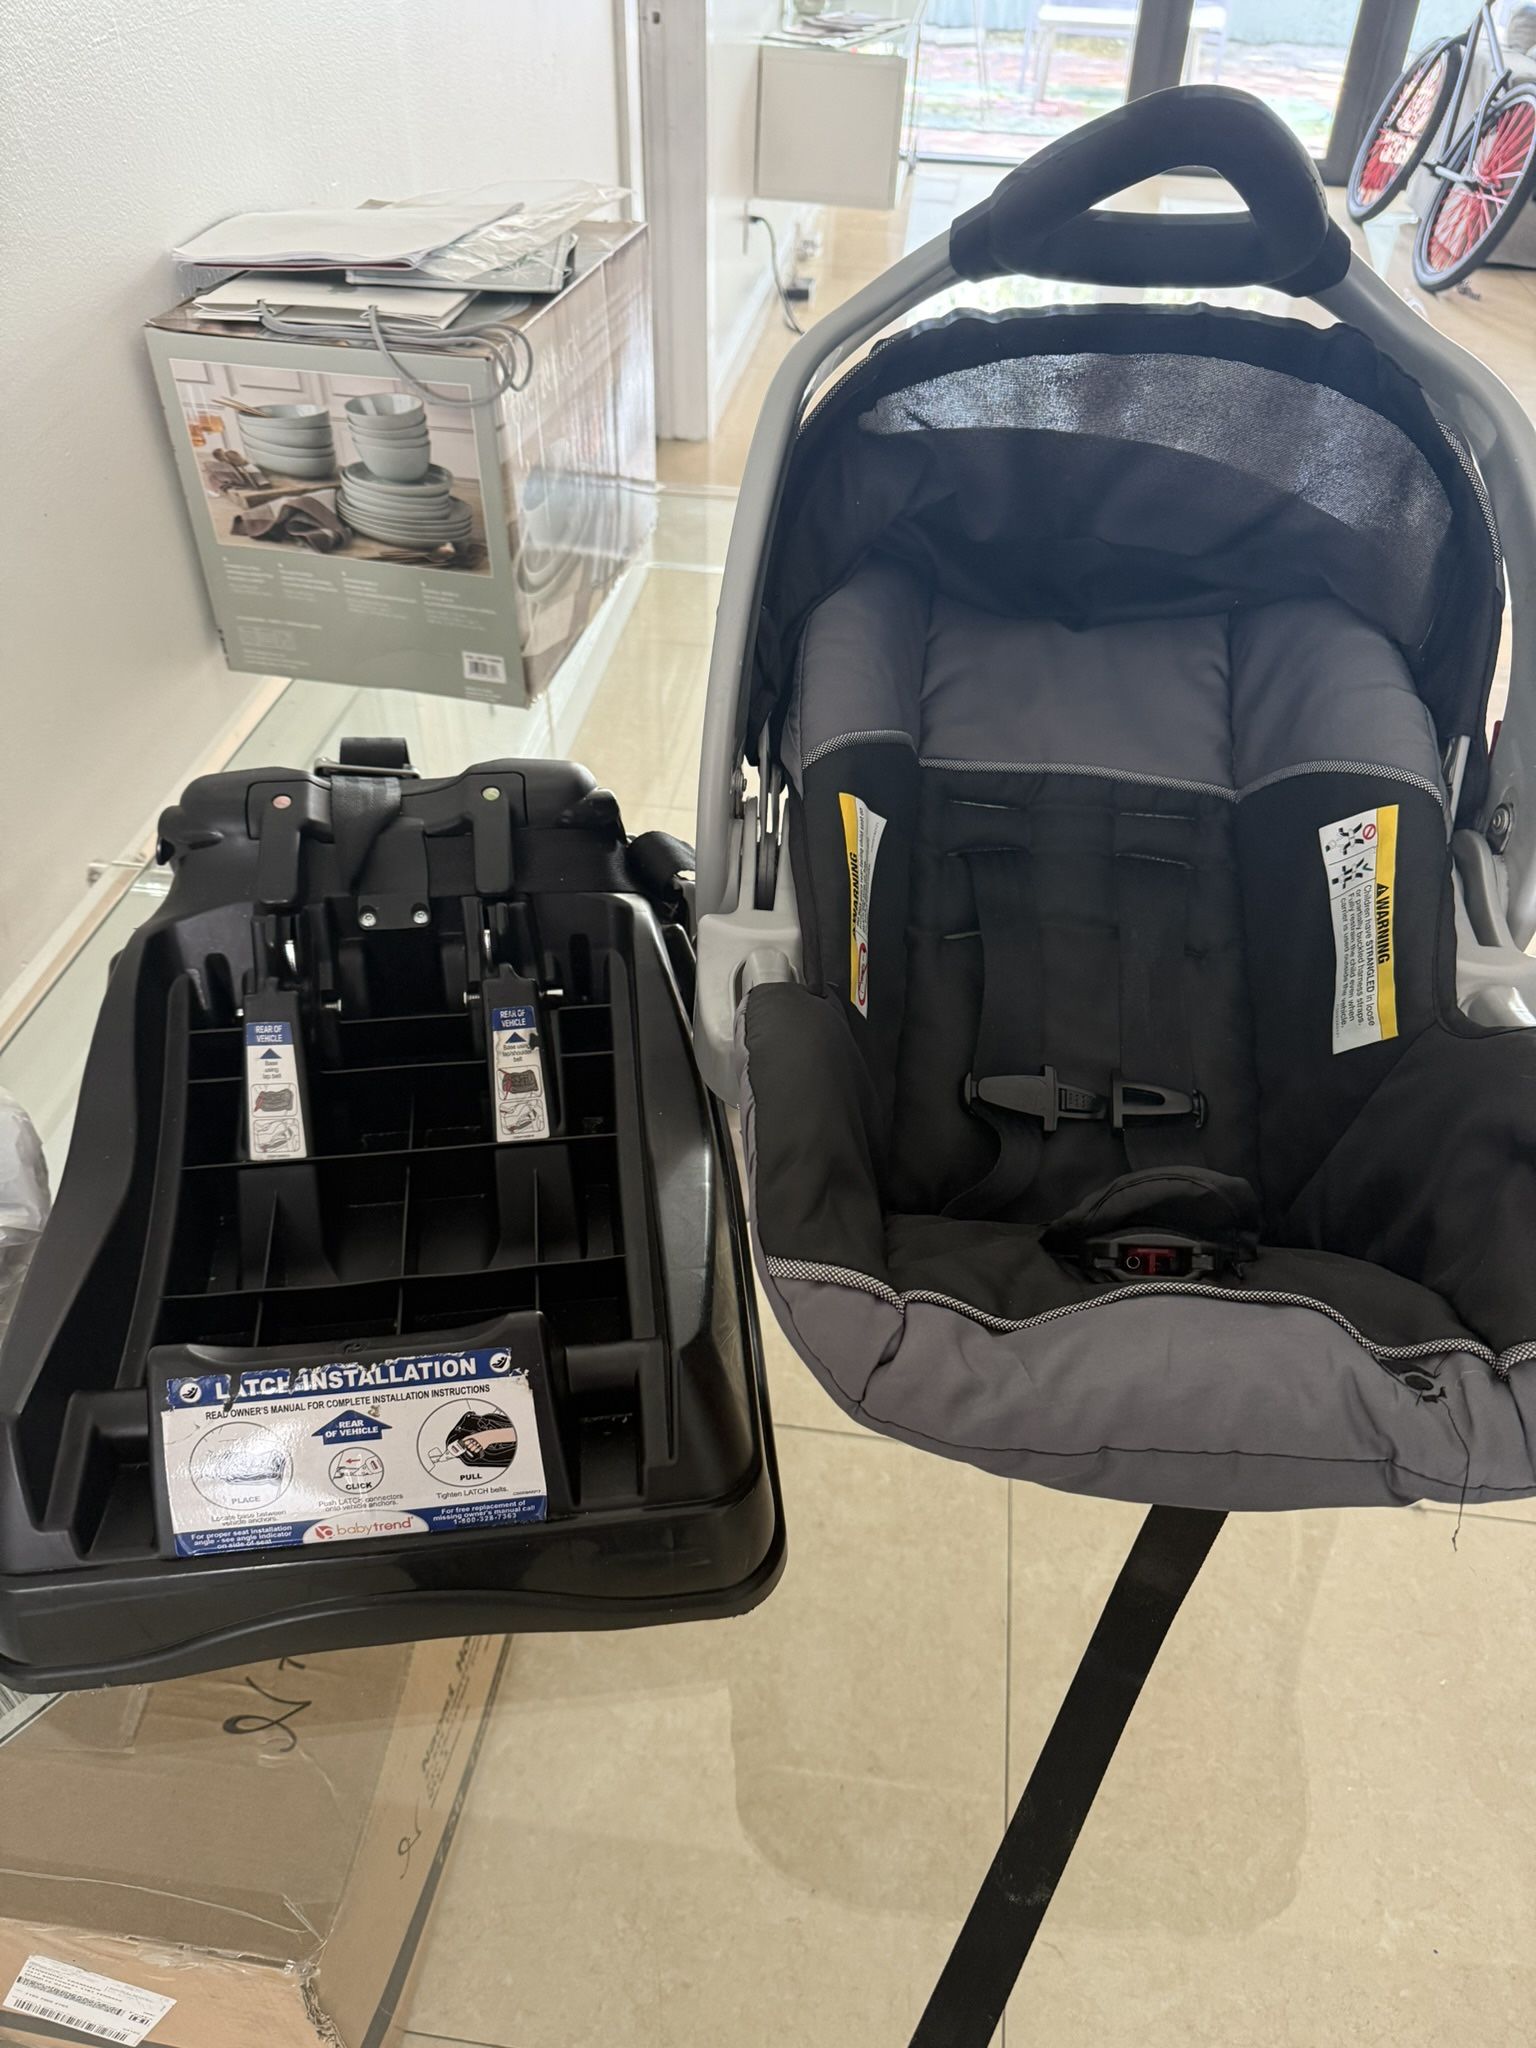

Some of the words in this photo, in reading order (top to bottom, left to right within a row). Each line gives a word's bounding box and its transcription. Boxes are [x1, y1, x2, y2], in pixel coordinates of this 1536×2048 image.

[850, 852, 858, 923] WARNING
[1355, 888, 1362, 897] or
[1347, 892, 1356, 912] Fully
[1363, 884, 1374, 917] Children
[1340, 898, 1348, 922] carrier
[1354, 899, 1365, 930] partially
[1349, 913, 1357, 942] restrain
[1364, 919, 1374, 939] have
[1376, 895, 1390, 964] WARNING
[1356, 931, 1366, 963] buckled
[1349, 958, 1357, 978] child
[1365, 940, 1375, 993] STRANGLED
[1357, 964, 1365, 996] harness
[1341, 983, 1349, 996] the
[1366, 994, 1374, 1003] in
[499, 1010, 517, 1019] REAR
[517, 1009, 526, 1017] OF
[1340, 997, 1348, 1028] vehicle.
[1348, 1000, 1356, 1021] when
[1356, 996, 1365, 1026] straps.
[1366, 1003, 1376, 1026] loose
[255, 1025, 272, 1034] REAR
[273, 1025, 283, 1033] OF
[501, 1018, 526, 1027] VEHICLE
[256, 1035, 283, 1043] VEHICLE
[300, 1357, 477, 1391] INSTALLATION
[205, 1410, 229, 1420] READ
[230, 1405, 270, 1418] OWNER'S
[270, 1402, 306, 1415] MANUAL
[307, 1400, 326, 1410] FOR
[326, 1395, 371, 1409] COMPLETE
[372, 1389, 430, 1404] INSTALLATION
[431, 1384, 490, 1398] INSTRUCTIONS
[324, 1430, 338, 1439] OF
[339, 1426, 379, 1438] VEHICLE
[338, 1419, 364, 1429] REAR
[345, 1481, 373, 1490] CLICK
[459, 1473, 482, 1481] PULL
[231, 1495, 261, 1505] PLACE
[318, 1500, 338, 1508] Push
[365, 1493, 404, 1502] connectors
[436, 1490, 462, 1500] Tighten
[463, 1487, 489, 1497] LATCH
[489, 1486, 508, 1494] belts.
[342, 1502, 367, 1511] vehicle
[368, 1499, 399, 1508] anchors.
[432, 1513, 463, 1522] missing
[463, 1509, 493, 1518] owner's
[493, 1506, 521, 1514] manual
[522, 1504, 536, 1512] call
[441, 1507, 454, 1515] For
[455, 1505, 470, 1513] free
[471, 1501, 517, 1512] replacement
[211, 1514, 236, 1522] Locate
[256, 1509, 287, 1518] between
[453, 1512, 517, 1525] 1-800-328-7363
[191, 1532, 205, 1541] For
[205, 1530, 232, 1541] proper
[232, 1529, 249, 1537] seat
[250, 1524, 293, 1536] installation
[337, 1517, 413, 1536] babytrend
[194, 1538, 215, 1547] angle
[235, 1534, 258, 1543] angle
[227, 1540, 244, 1549] side
[252, 1538, 273, 1546] seat
